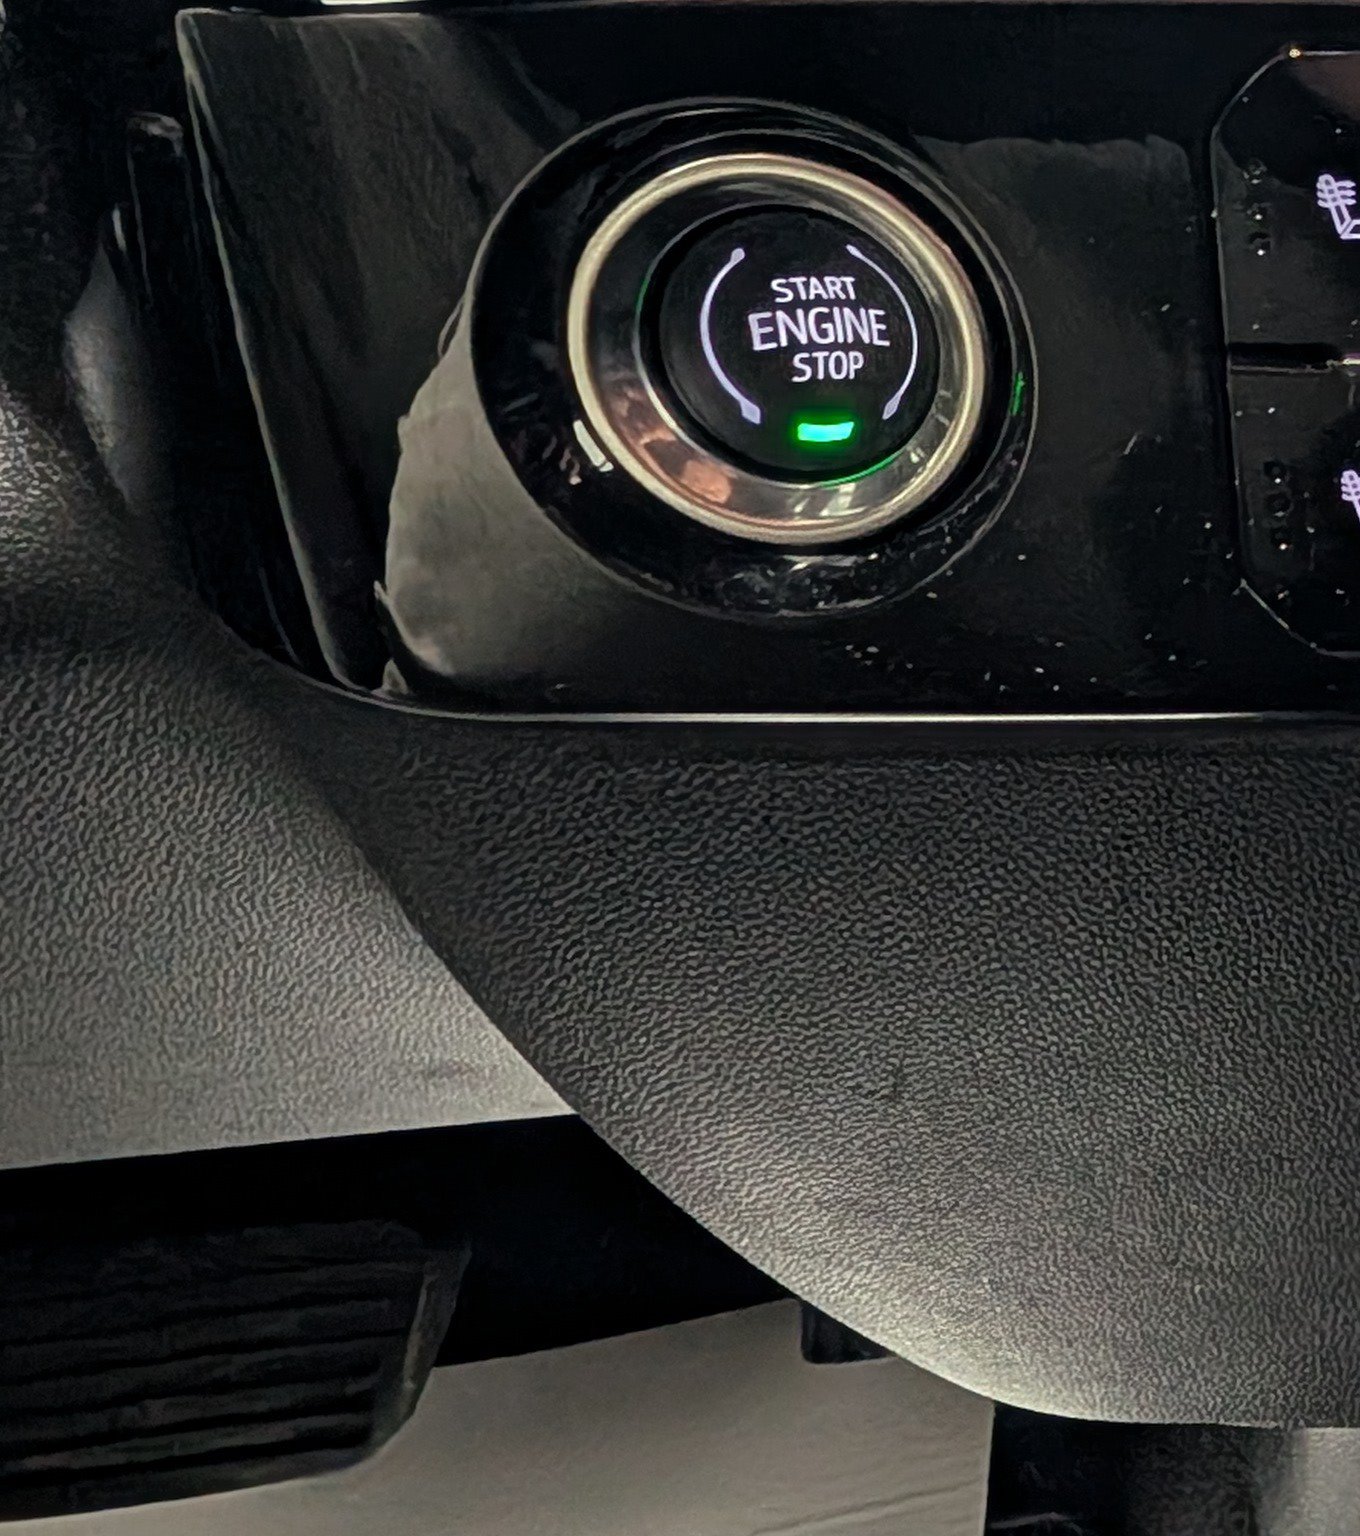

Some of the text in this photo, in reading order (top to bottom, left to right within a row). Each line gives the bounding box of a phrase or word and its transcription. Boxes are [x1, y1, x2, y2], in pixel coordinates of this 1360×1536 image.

[770, 275, 856, 303] START
[747, 306, 891, 352] ENGINE
[791, 350, 865, 383] STOP
